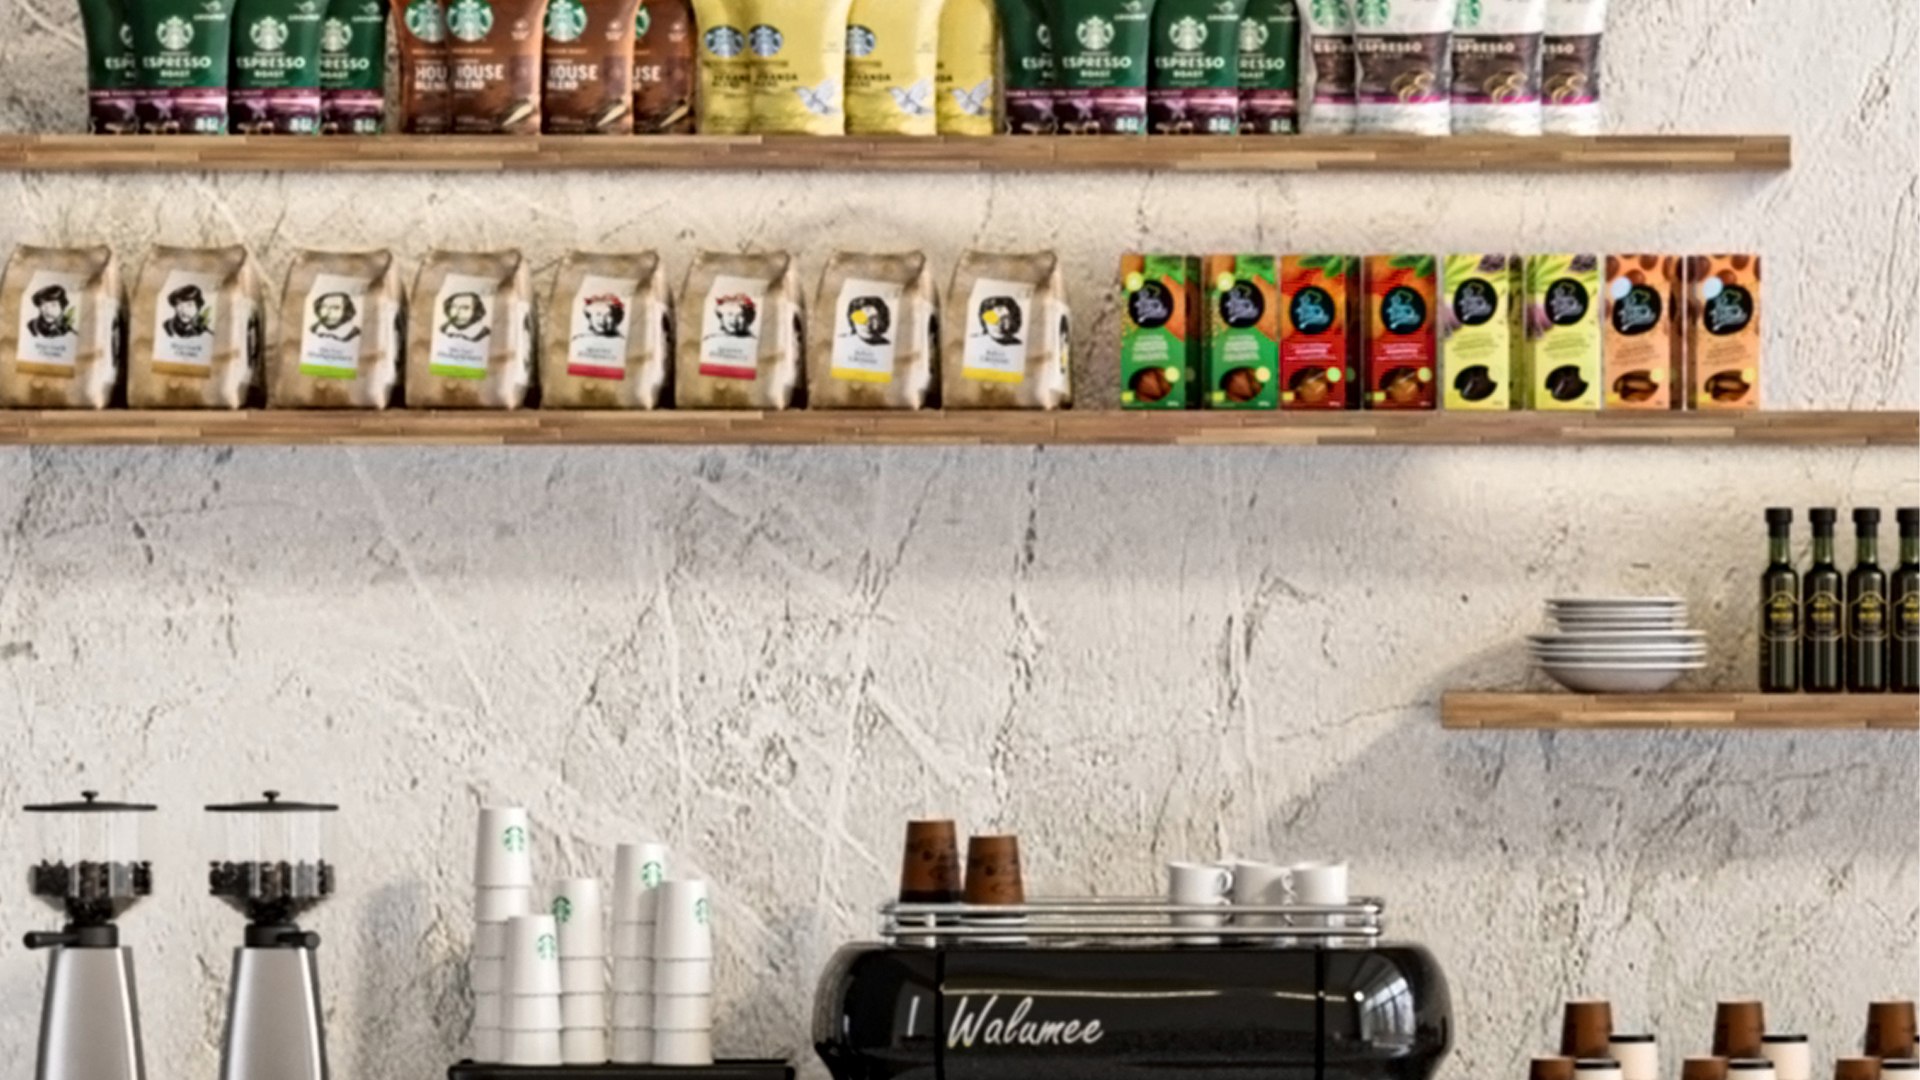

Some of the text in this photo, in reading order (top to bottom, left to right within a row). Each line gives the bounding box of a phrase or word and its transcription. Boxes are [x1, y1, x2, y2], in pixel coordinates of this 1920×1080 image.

[143, 56, 212, 69] ESPRESSO
[236, 56, 306, 69] ESPRESSO
[320, 57, 370, 70] RESSO
[1062, 56, 1132, 69] ESPRESSO
[1155, 56, 1226, 69] ESPRESSO
[946, 993, 1105, 1049] Walumee
